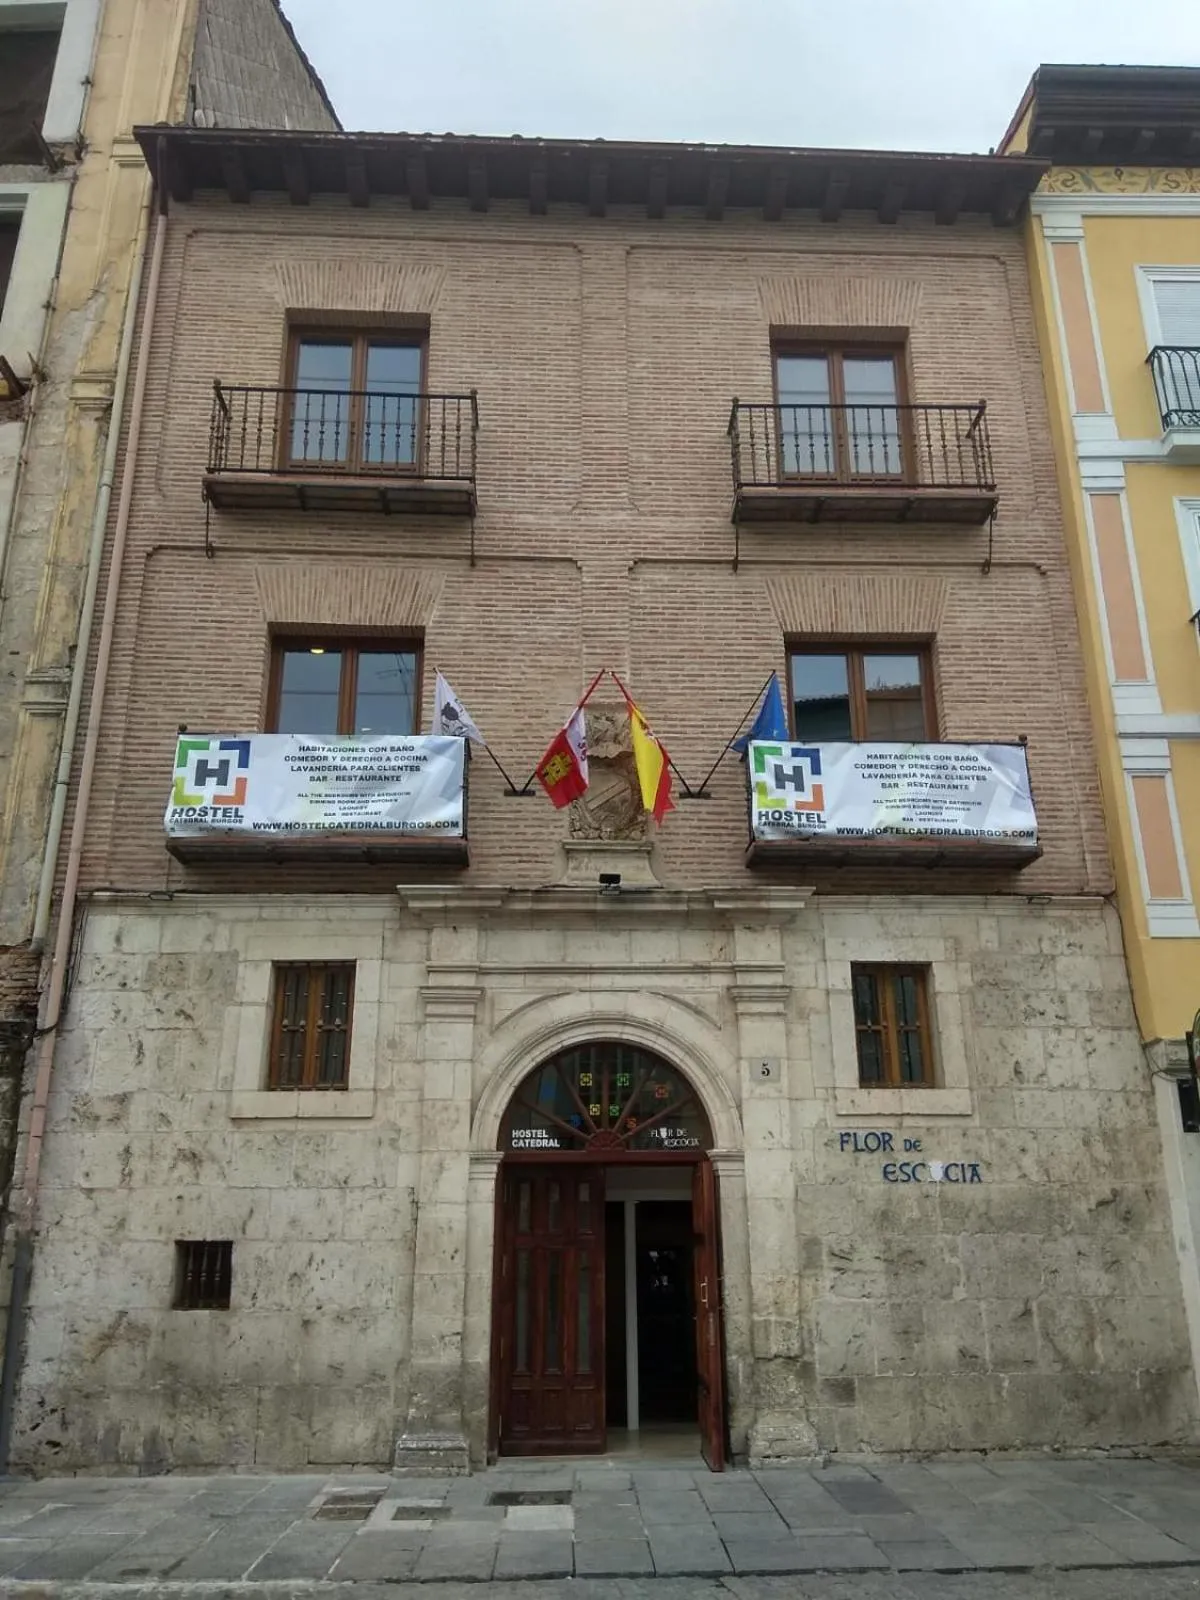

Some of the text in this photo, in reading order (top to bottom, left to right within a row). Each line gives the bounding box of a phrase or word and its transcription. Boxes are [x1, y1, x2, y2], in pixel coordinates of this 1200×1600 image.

[298, 745, 366, 753] HABITACIONES
[866, 753, 931, 761] HABITACIONES
[908, 763, 948, 771] DERECHO
[194, 759, 230, 786] H
[336, 774, 402, 782] RESTAURANTE
[774, 764, 804, 792] H
[944, 774, 987, 782] CLIENTES
[907, 782, 970, 790] RESTAURANTE
[170, 806, 244, 818] HOSTEL
[758, 810, 826, 824] HOSTEL
[252, 821, 460, 830] WWW.HOSTELCATEDRALBURGOS.COM
[836, 827, 1034, 838] WWW.HOSTELCATEDRALBURGOS.COM
[761, 1063, 770, 1077] 5
[512, 1130, 548, 1138] HOSTEL
[650, 1128, 674, 1138] FLR
[512, 1138, 560, 1148] CATEDRAL
[840, 1132, 894, 1153] FLOR
[883, 1161, 983, 1183] ESCCIA
